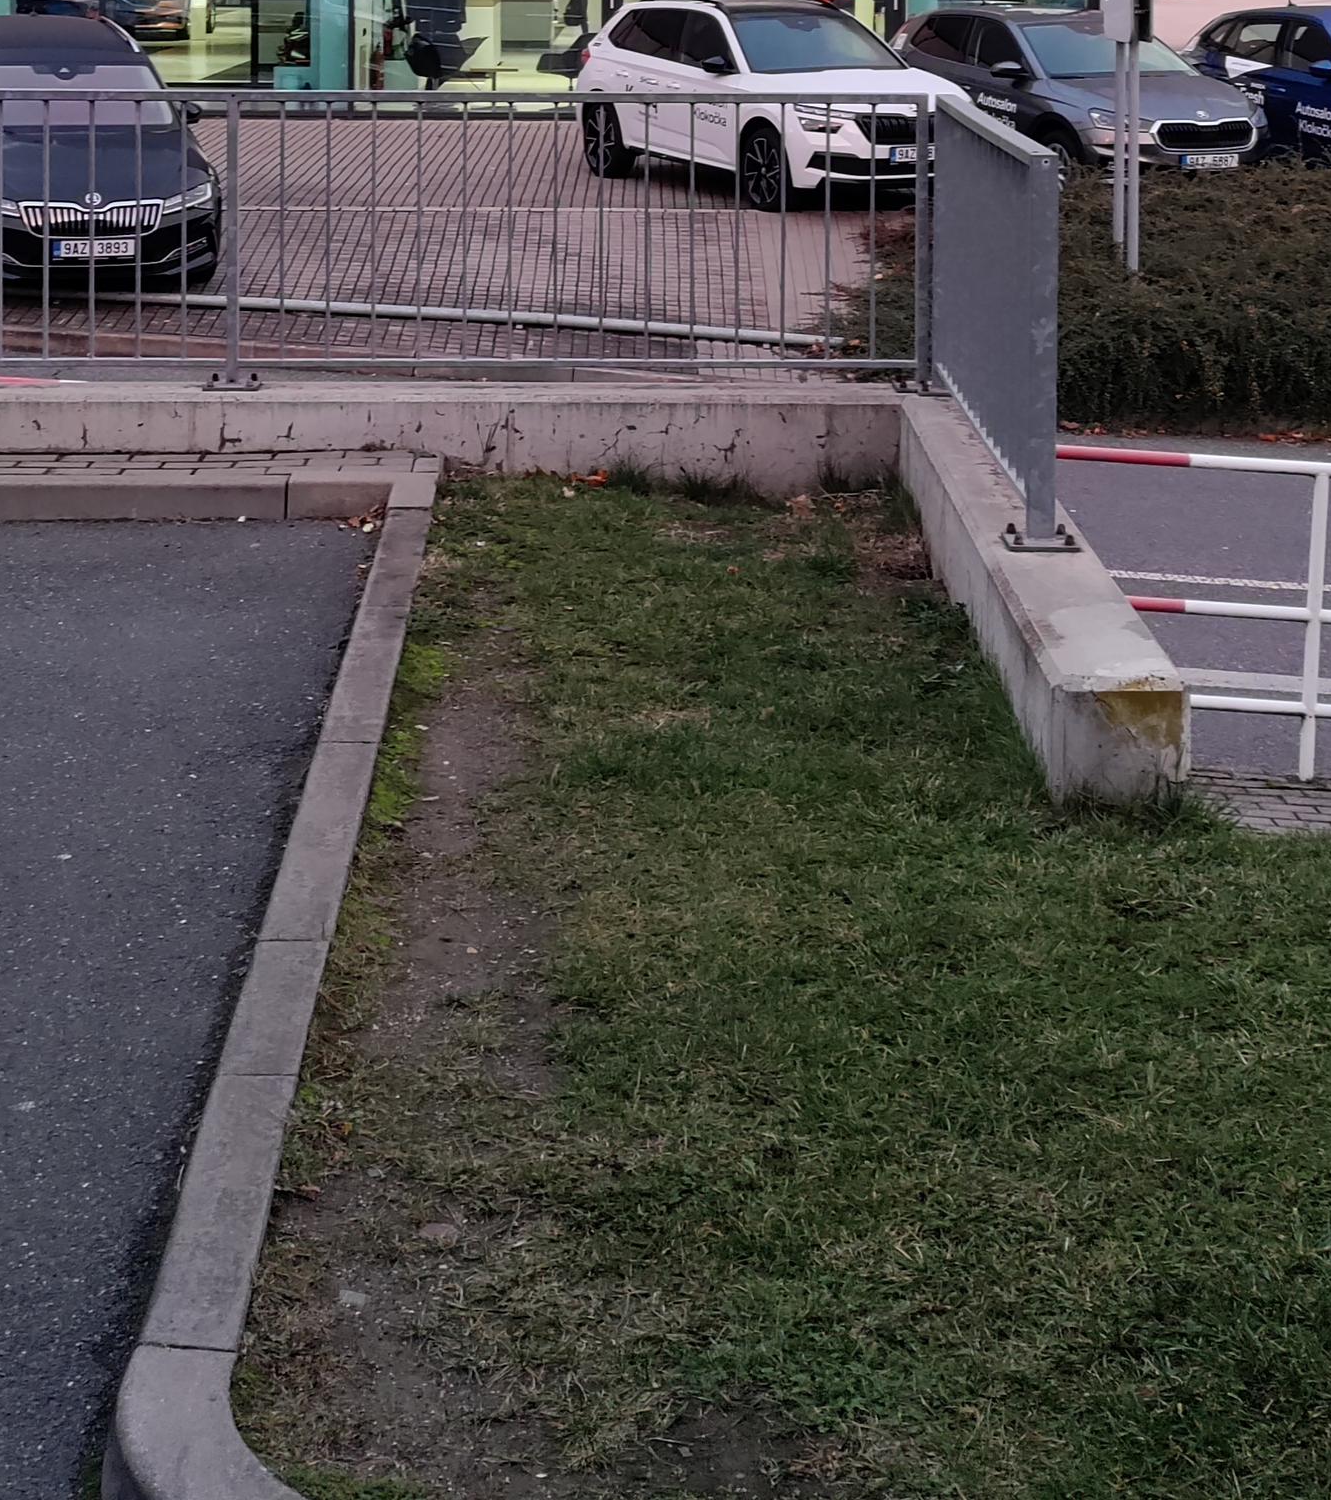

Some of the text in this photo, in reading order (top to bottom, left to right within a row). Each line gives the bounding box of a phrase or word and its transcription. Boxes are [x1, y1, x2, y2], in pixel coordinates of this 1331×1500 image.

[977, 92, 1017, 113] Autosalon
[64, 242, 128, 255] 9AZ 3893
